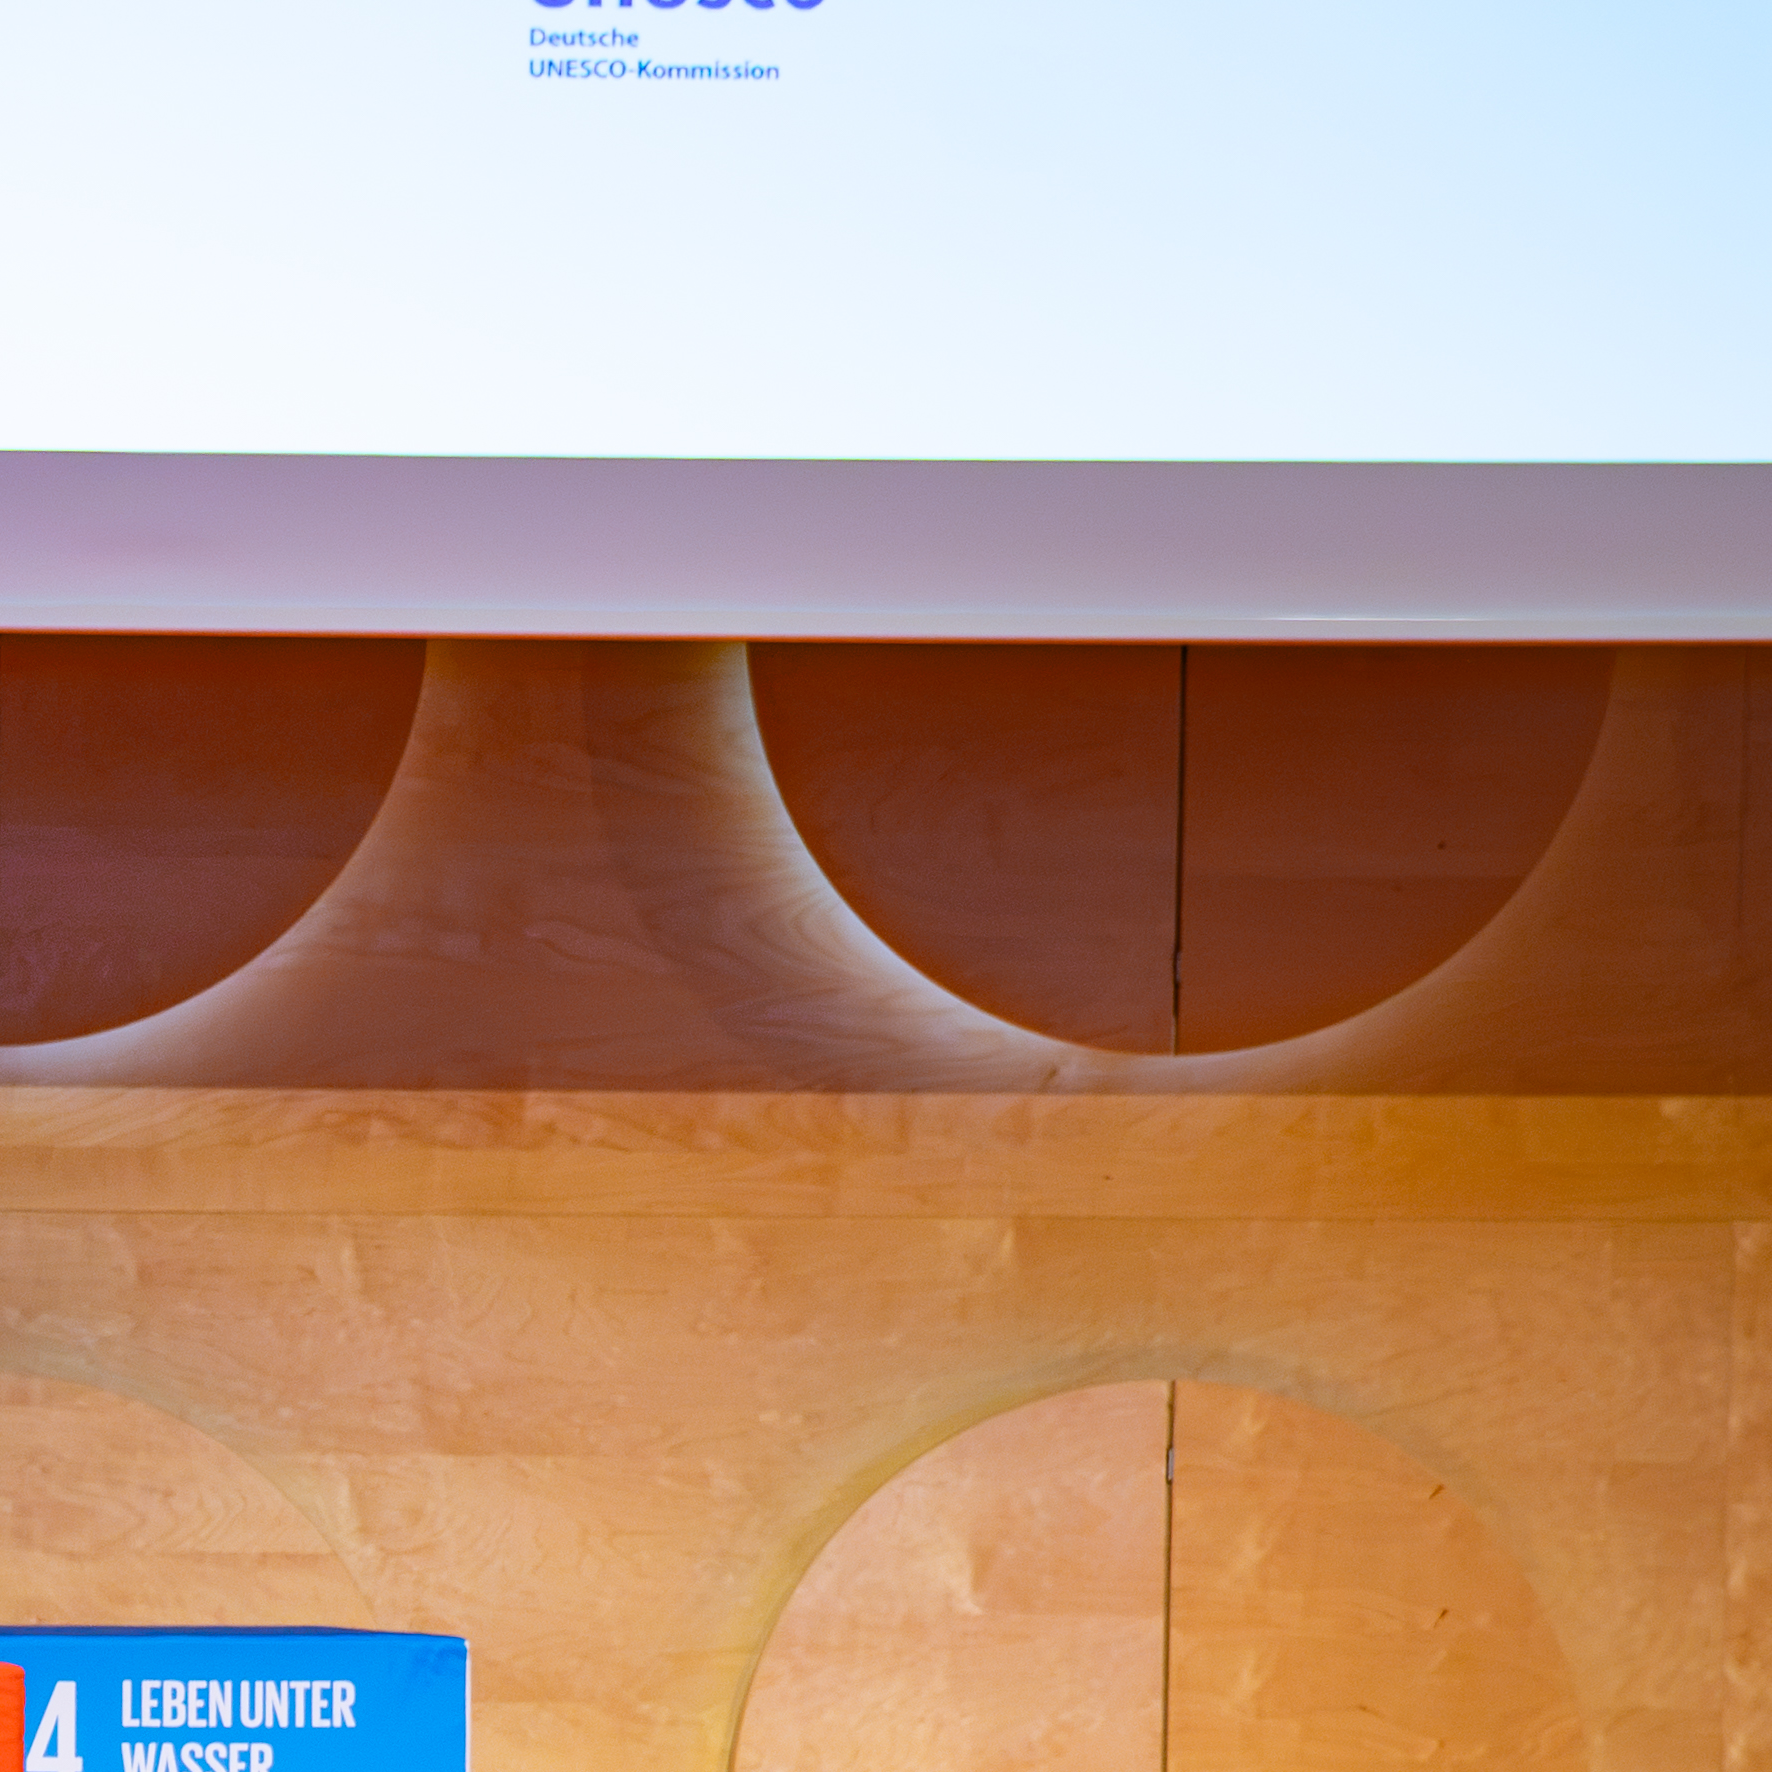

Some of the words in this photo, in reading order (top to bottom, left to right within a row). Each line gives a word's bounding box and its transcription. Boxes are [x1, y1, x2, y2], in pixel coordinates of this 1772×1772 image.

[528, 27, 640, 48] Deutsche
[528, 58, 781, 81] UNESCO-Kommission
[121, 1679, 233, 1729] LEBEN
[240, 1679, 357, 1729] UNTER
